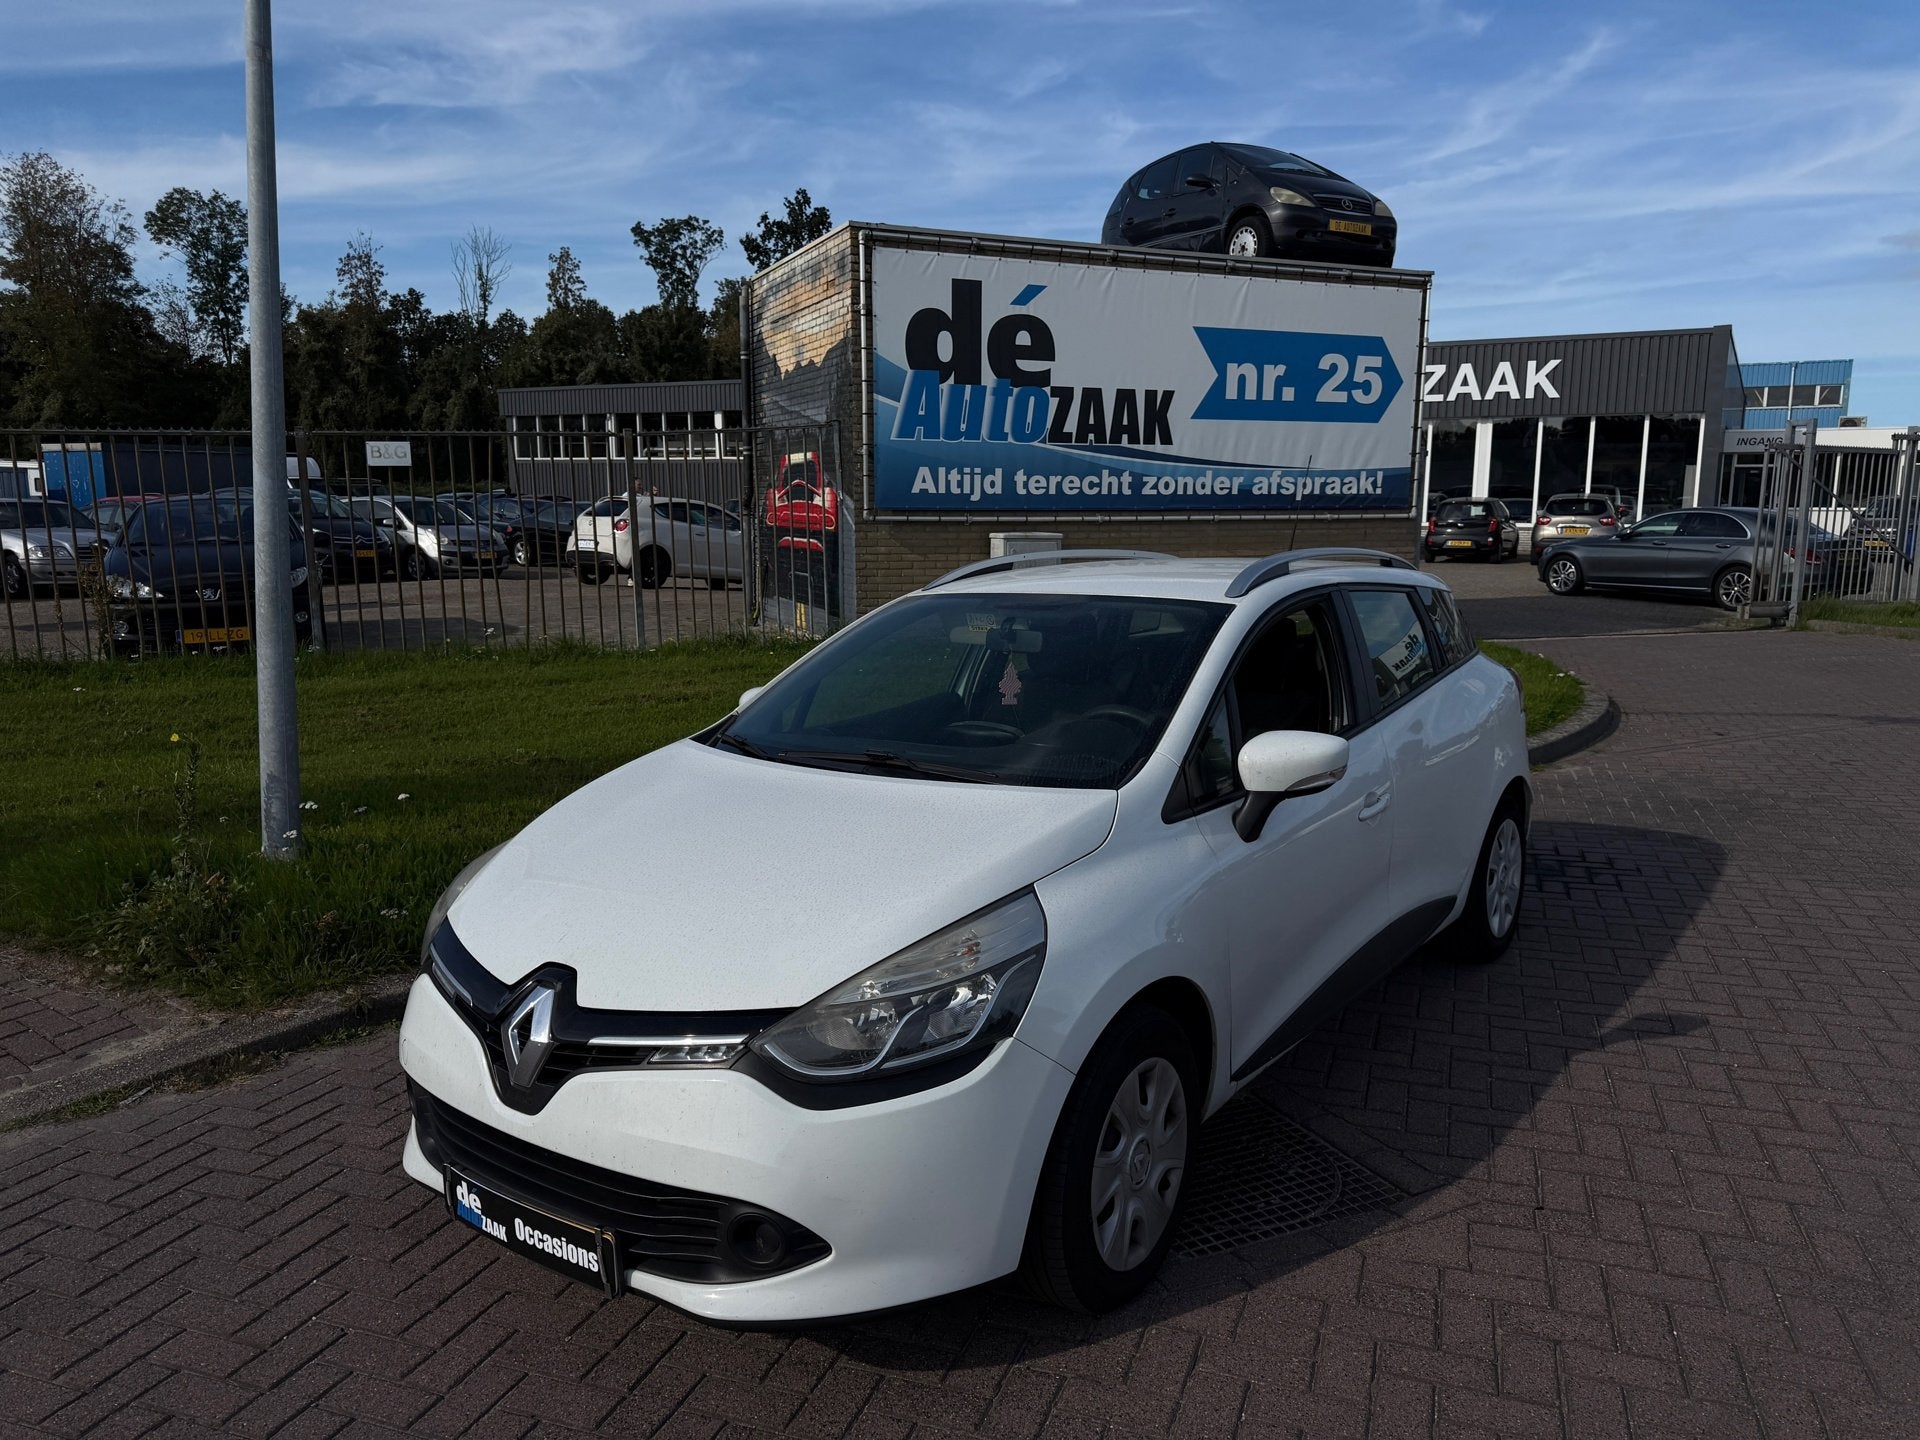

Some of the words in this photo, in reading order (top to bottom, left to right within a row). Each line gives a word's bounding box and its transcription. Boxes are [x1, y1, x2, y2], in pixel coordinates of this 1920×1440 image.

[905, 278, 1056, 387] dé
[1225, 363, 1295, 402] nr.
[1315, 353, 1383, 405] 25
[1423, 358, 1563, 402] ZAAK
[370, 443, 408, 460] B&G
[1736, 436, 1784, 446] INGANG
[911, 466, 1002, 501] Altijd
[1014, 468, 1132, 495] terecht
[1141, 470, 1245, 495] zonder
[1252, 470, 1384, 501] afspraak!
[456, 1180, 482, 1215] dé
[514, 1217, 600, 1273] Occasions
